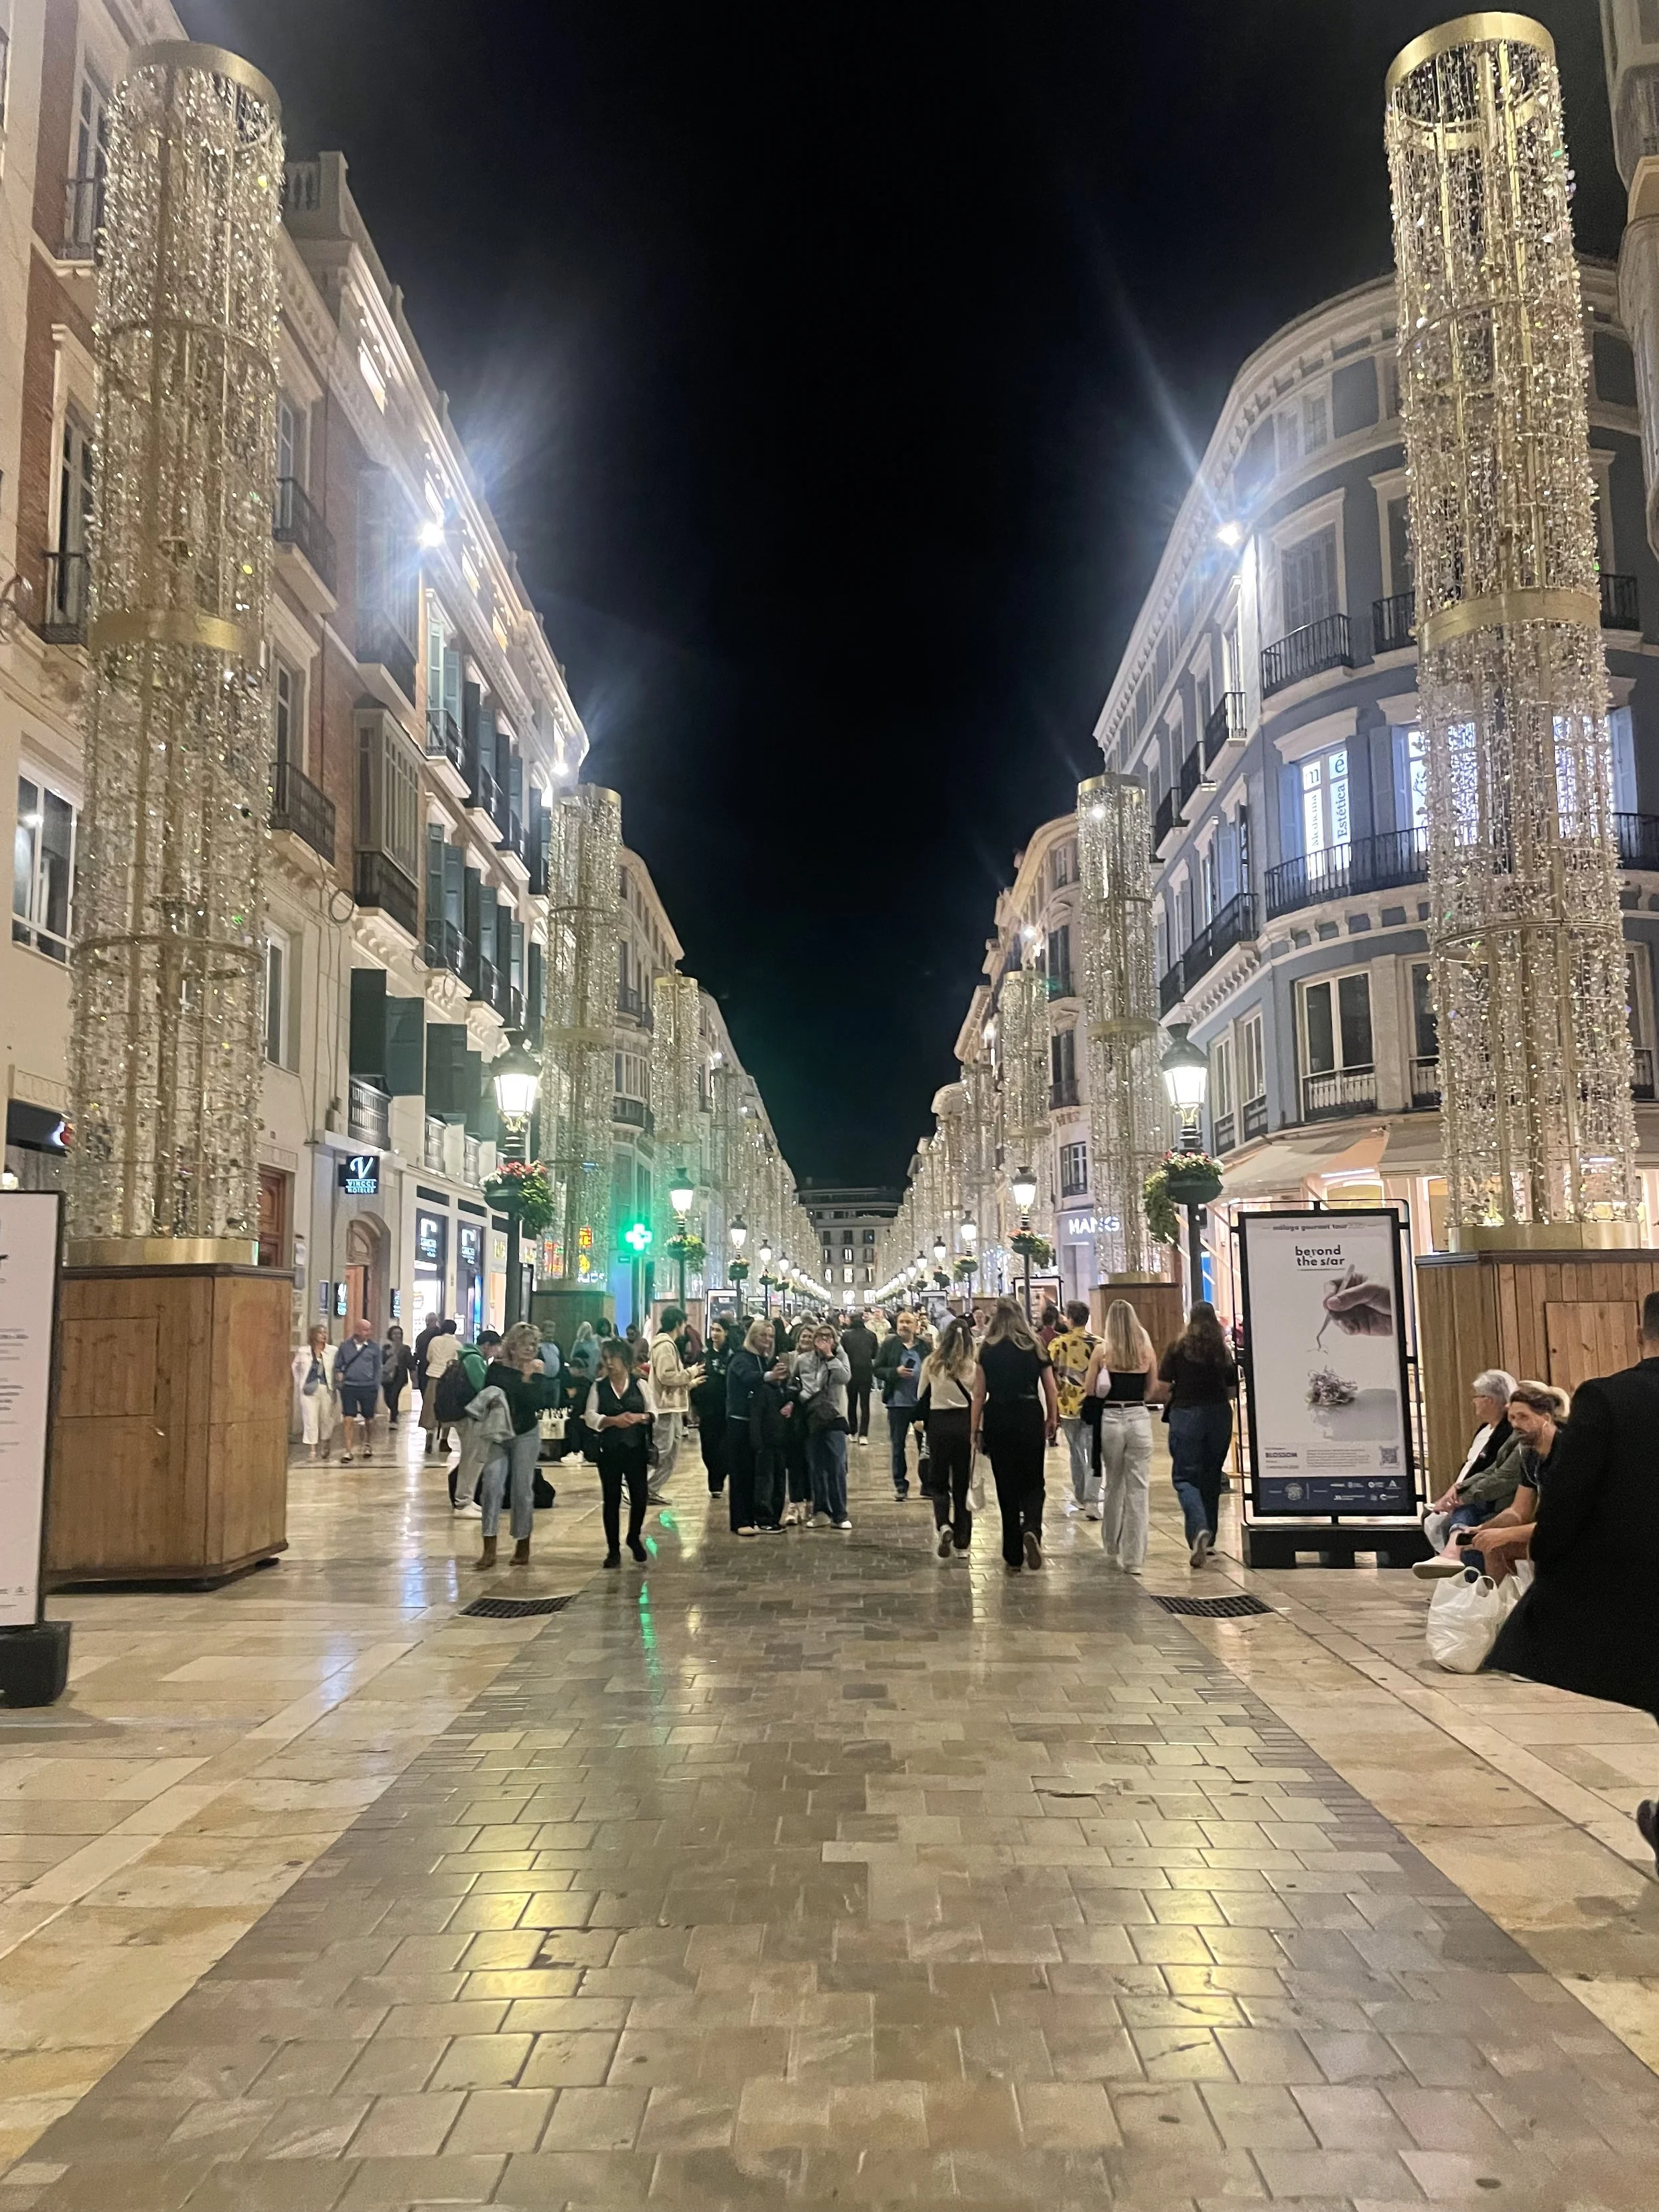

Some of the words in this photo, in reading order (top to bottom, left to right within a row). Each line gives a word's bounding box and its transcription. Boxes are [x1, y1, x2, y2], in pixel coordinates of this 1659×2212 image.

[1336, 783, 1348, 839] Estética
[1295, 1245, 1340, 1258] beyond
[1297, 1256, 1318, 1266] the
[1321, 1257, 1345, 1266] star
